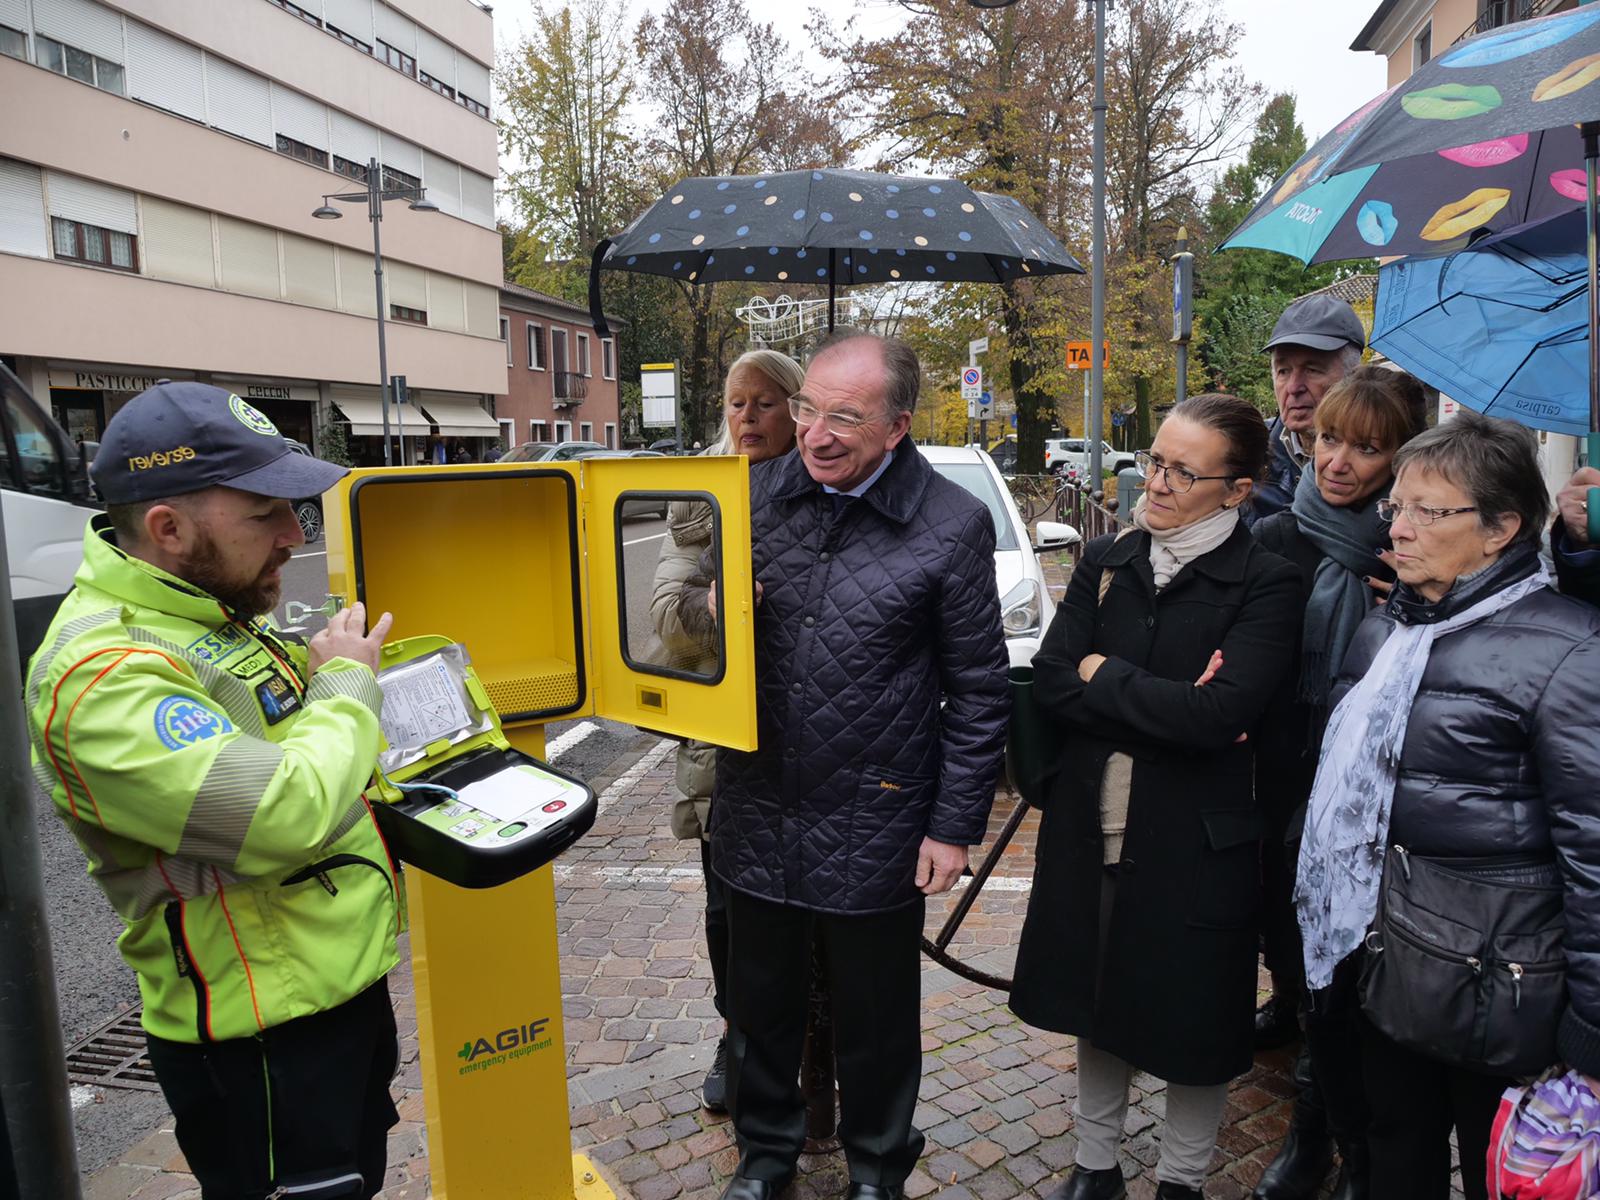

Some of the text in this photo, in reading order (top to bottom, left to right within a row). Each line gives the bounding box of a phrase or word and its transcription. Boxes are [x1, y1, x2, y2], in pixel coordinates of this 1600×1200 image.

[1069, 348, 1106, 361] TAI
[175, 709, 212, 736] 118
[468, 1017, 550, 1062] AGIF
[459, 1037, 553, 1075] emergency equipment
